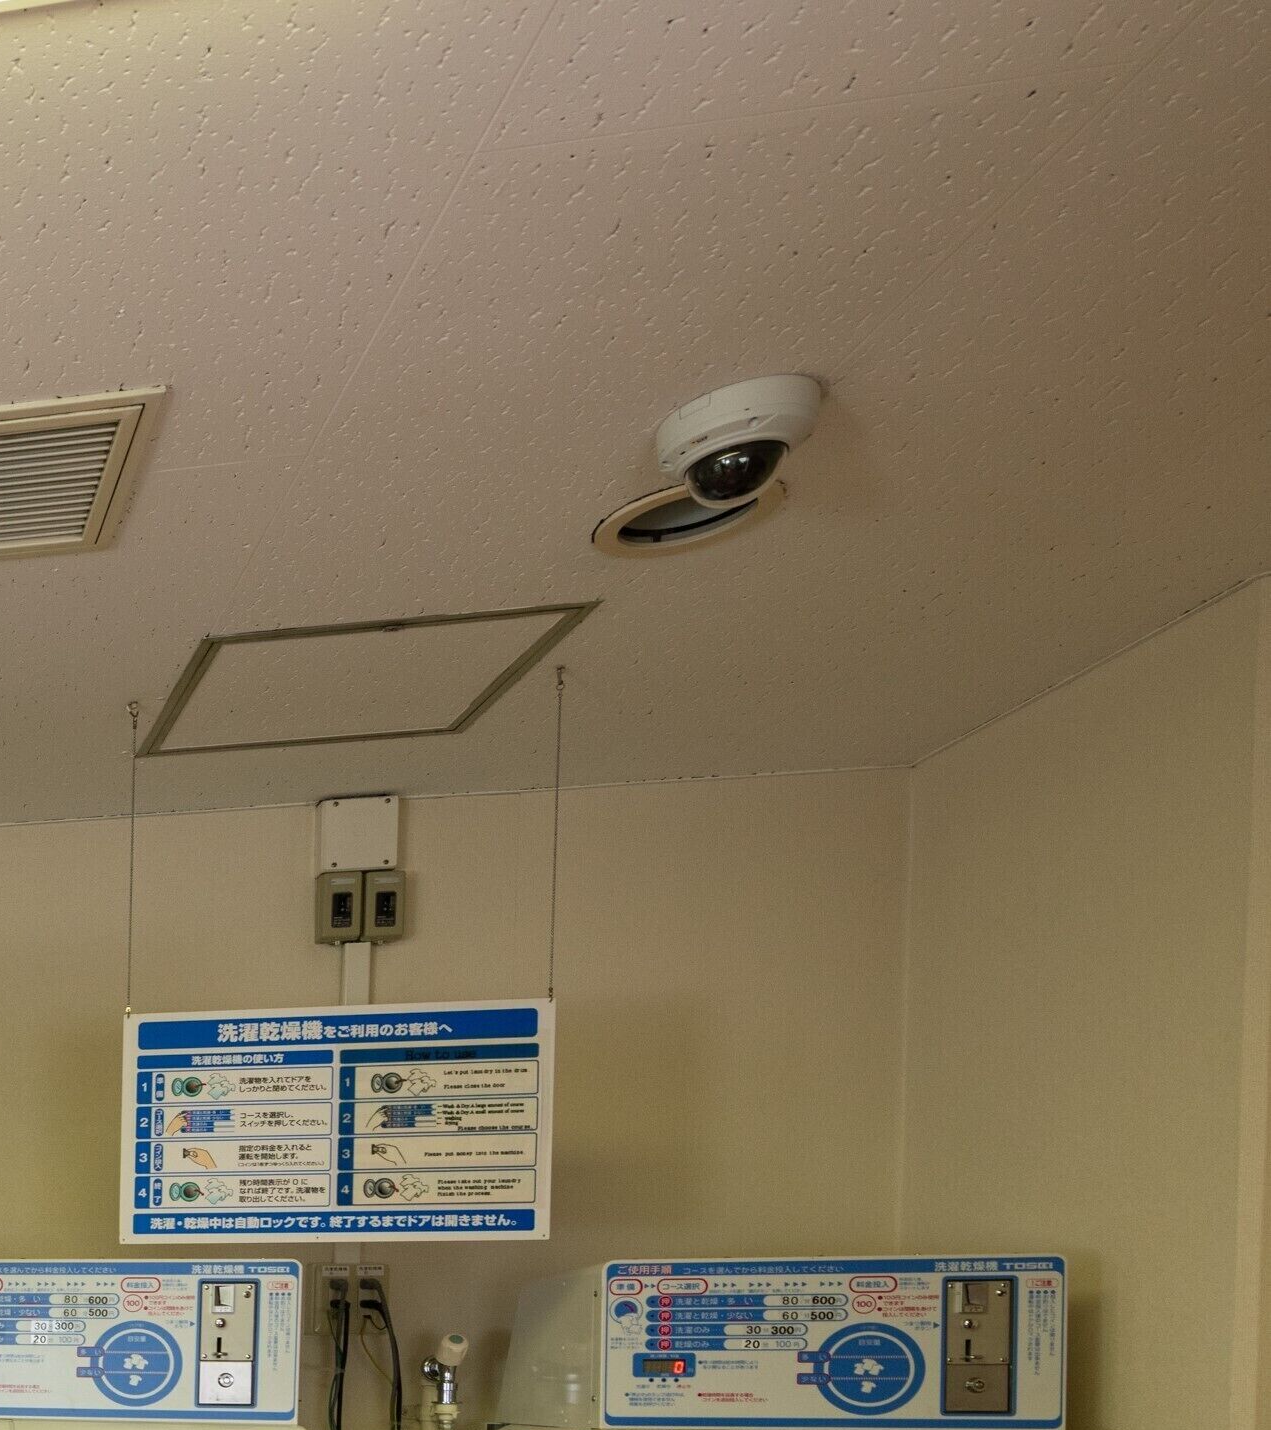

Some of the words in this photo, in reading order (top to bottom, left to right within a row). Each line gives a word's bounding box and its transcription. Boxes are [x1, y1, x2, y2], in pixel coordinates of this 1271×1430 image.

[217, 1020, 453, 1043] 洗濯乾燥機をご利用のお客様へ
[191, 1053, 284, 1066] 洗濯乾燥機の使い方
[407, 1050, 430, 1061] How
[435, 1050, 450, 1060] to
[239, 1076, 312, 1085] 洗濯物を入れてドアを
[137, 1187, 147, 1197] 4
[341, 1185, 350, 1195] 4
[191, 1264, 245, 1275] 洗濯乾燥機
[248, 1265, 290, 1273] TOSEI
[617, 1265, 673, 1275] ご使用手順
[934, 1261, 999, 1272] 洗濯乾燥機
[1003, 1262, 1053, 1270] TOSEI
[662, 1282, 701, 1291] コース選択
[63, 1295, 78, 1303] 80
[87, 1296, 108, 1305] 600
[782, 1296, 799, 1305] 80
[811, 1295, 836, 1305] 600
[87, 1308, 108, 1317] 500
[782, 1311, 799, 1320] 60
[810, 1311, 834, 1320] 500
[33, 1322, 47, 1330] 30
[54, 1322, 74, 1330] 300
[746, 1325, 762, 1335] 30
[770, 1325, 795, 1335] 300
[33, 1335, 47, 1343] 20
[744, 1340, 761, 1349] 20
[673, 1360, 684, 1374] 0
